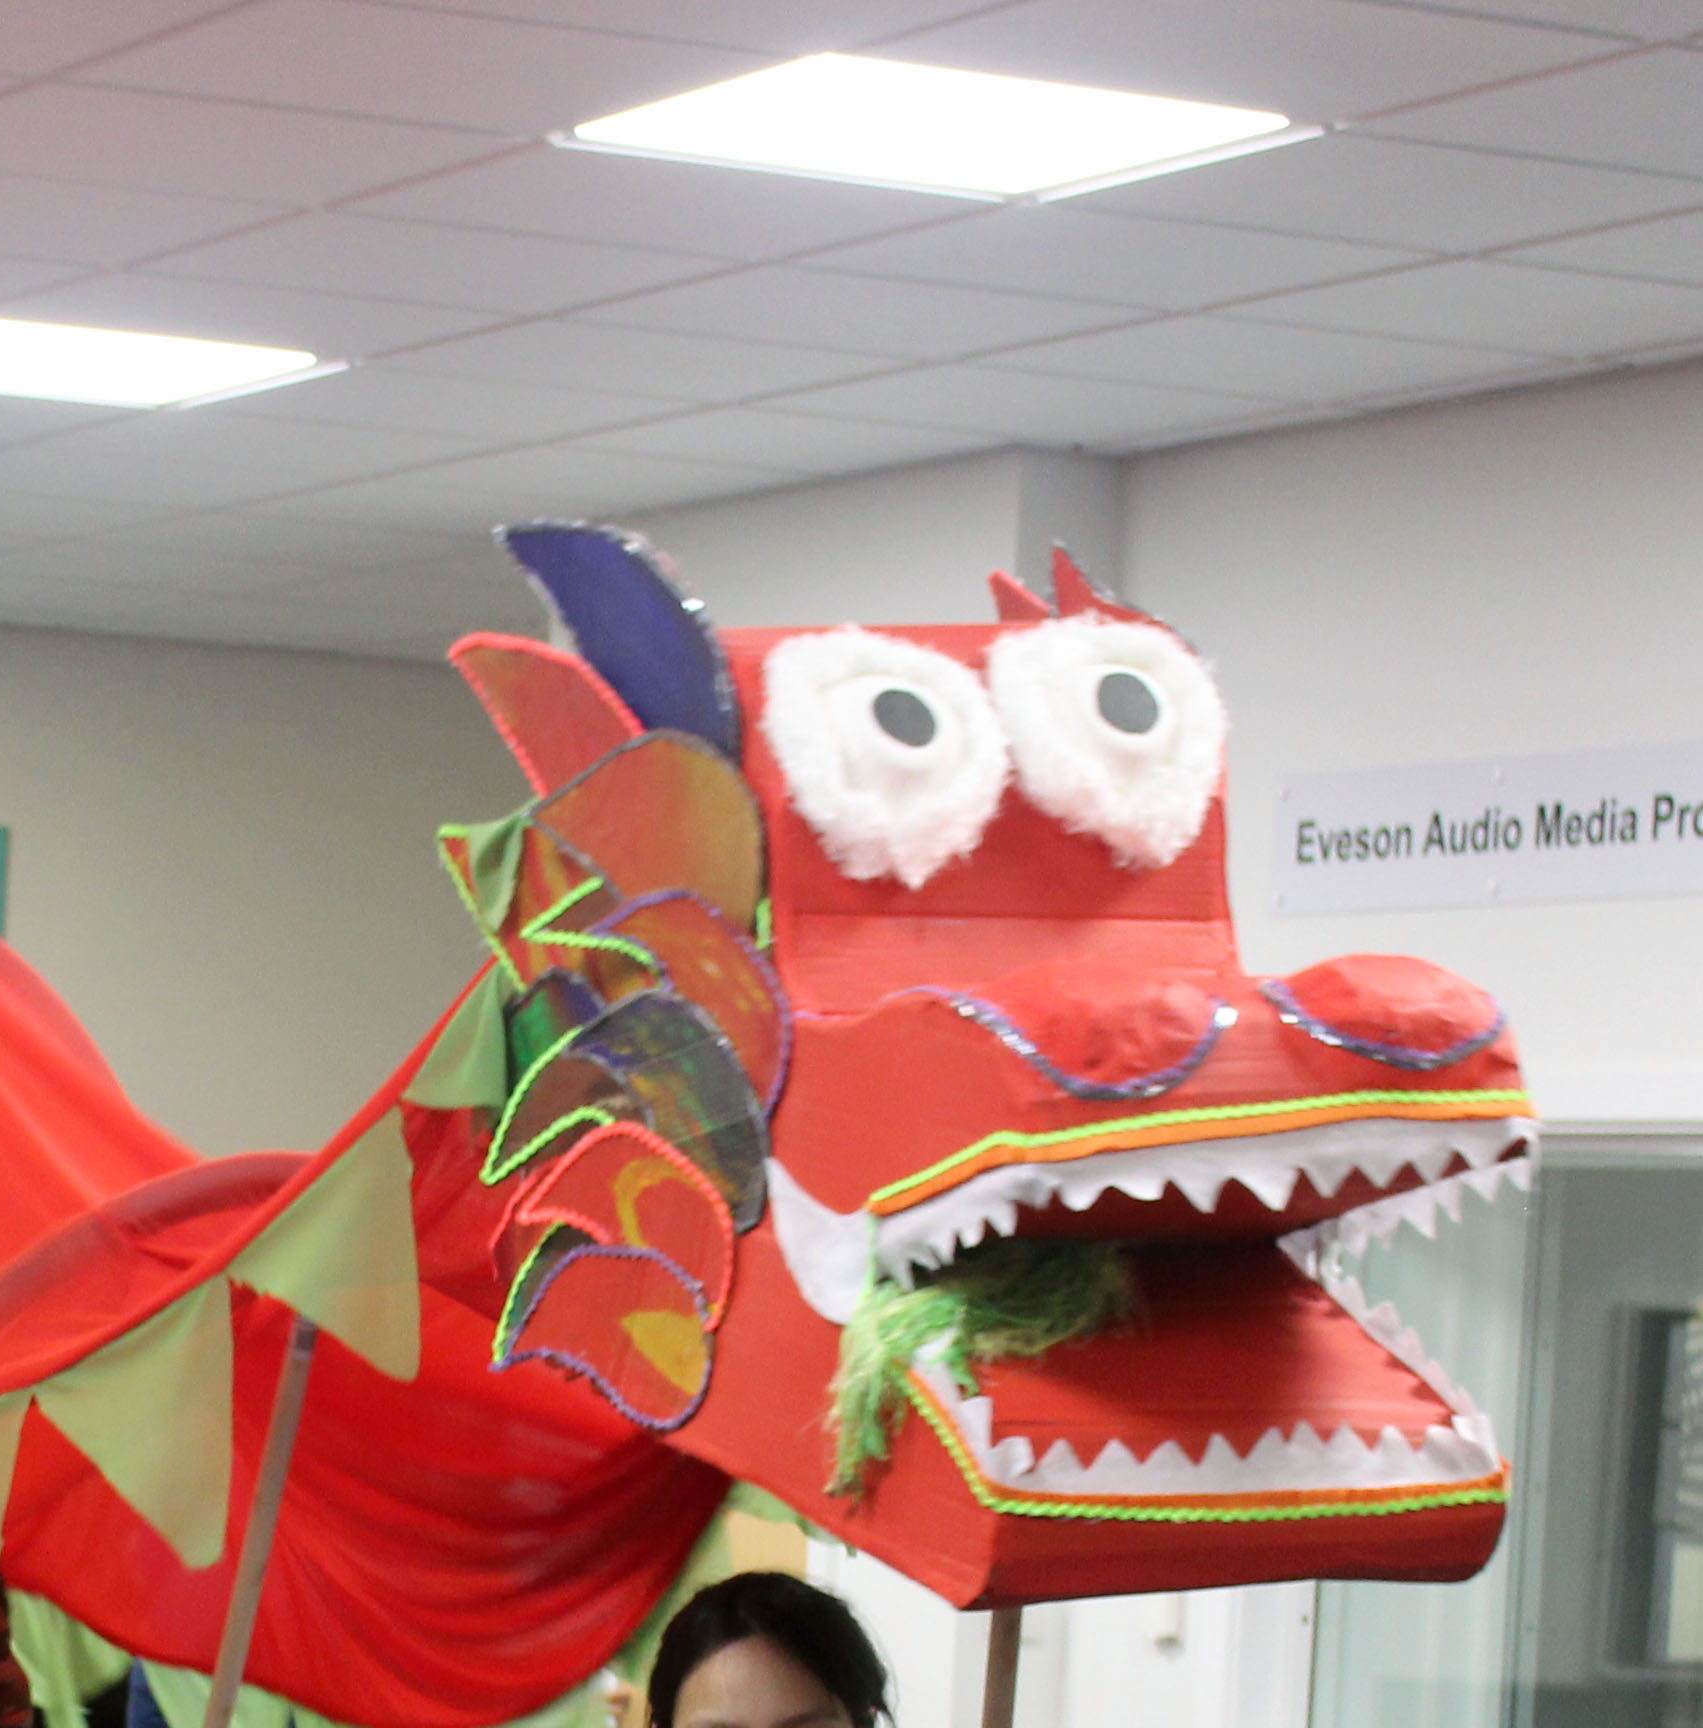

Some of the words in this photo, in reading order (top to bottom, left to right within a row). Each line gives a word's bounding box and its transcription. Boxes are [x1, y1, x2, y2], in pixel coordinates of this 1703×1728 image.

[1297, 820, 1413, 864] Eveson
[1423, 807, 1523, 857] Audio
[1534, 796, 1638, 849] Media
